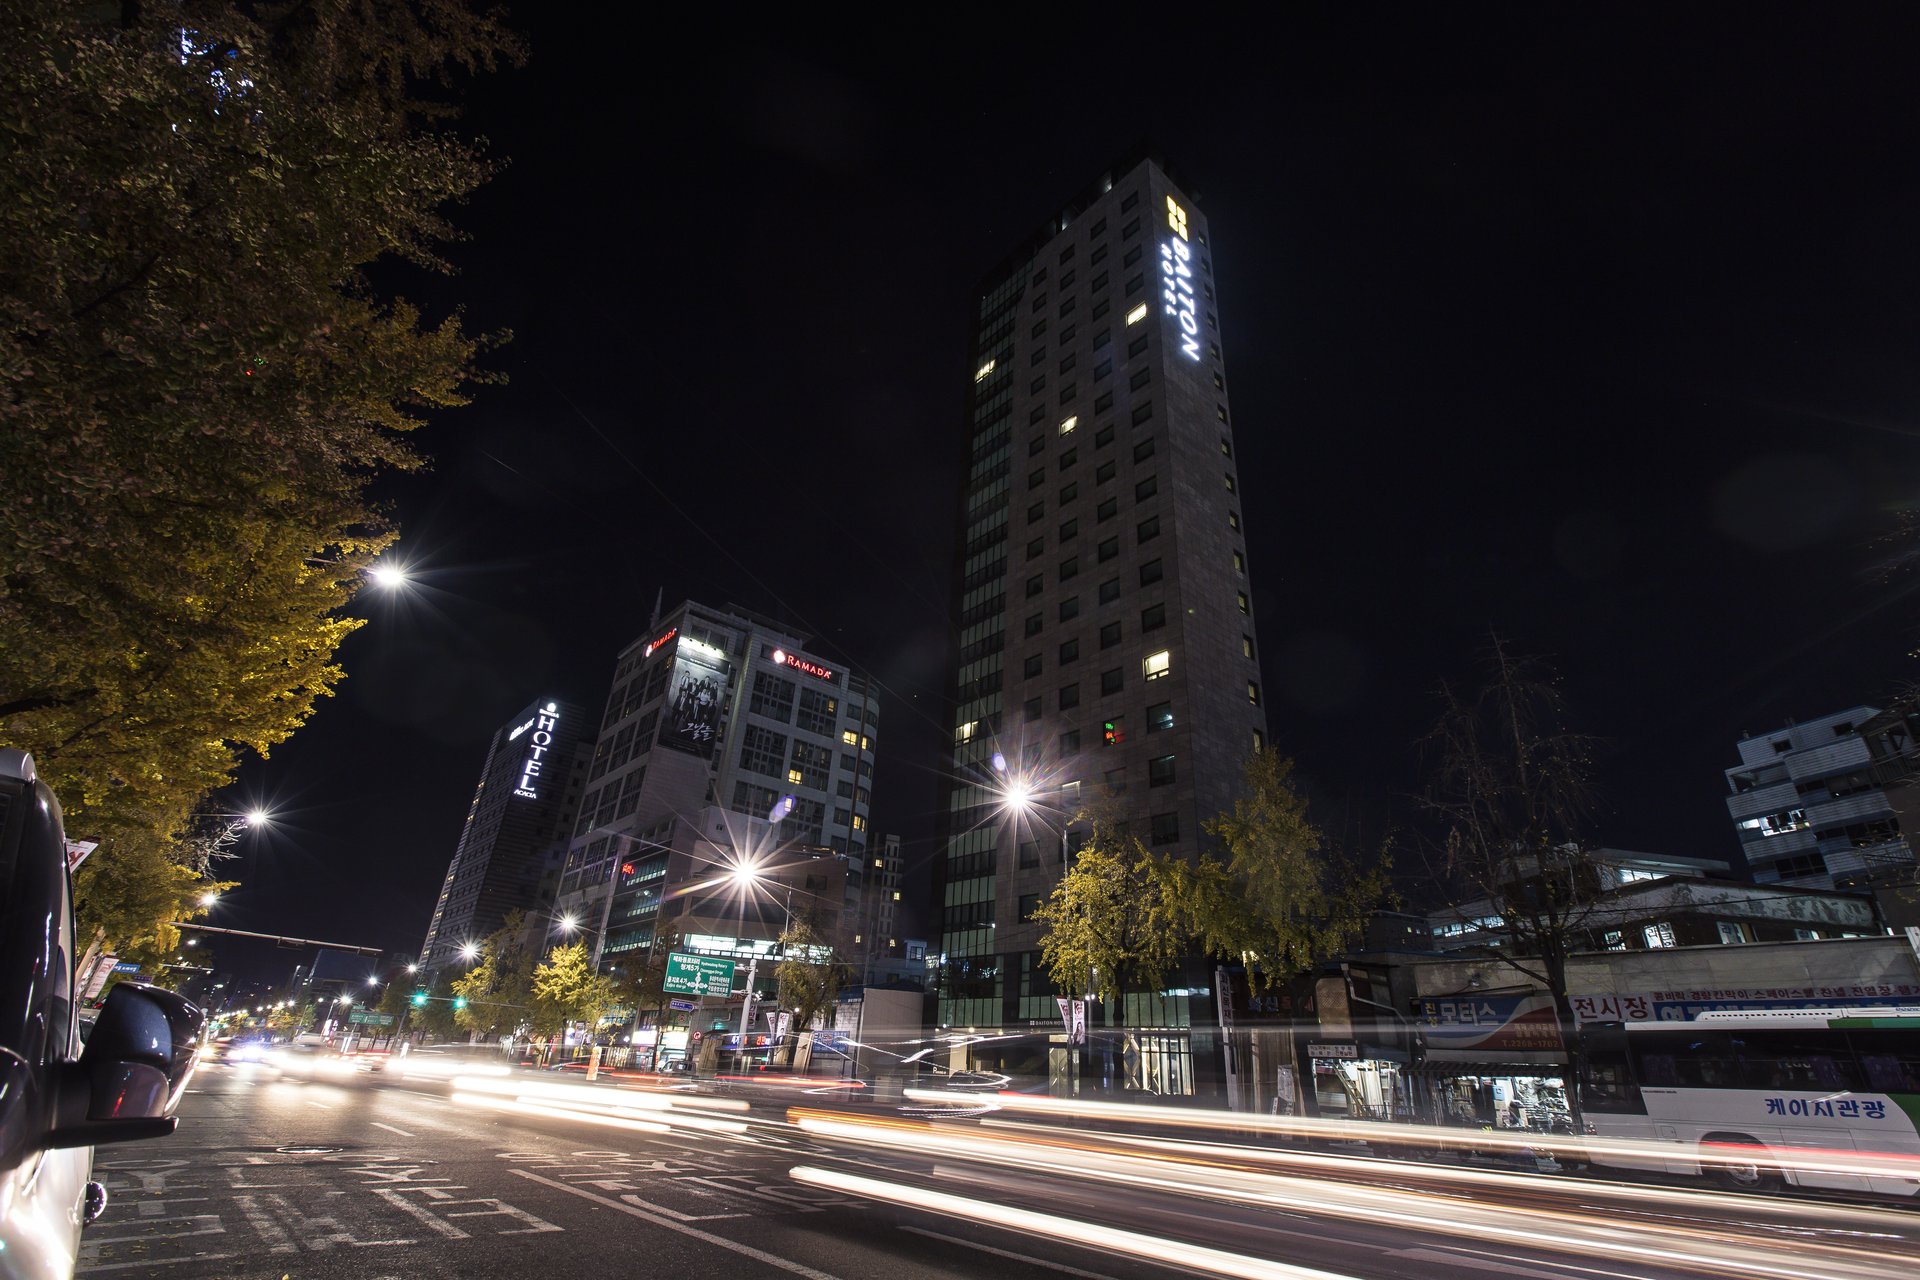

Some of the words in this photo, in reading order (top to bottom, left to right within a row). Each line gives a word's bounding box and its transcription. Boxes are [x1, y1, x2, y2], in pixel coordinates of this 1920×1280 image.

[1161, 243, 1177, 316] HOTEL
[1172, 237, 1200, 361] BAITON
[652, 628, 675, 650] RAMADA
[787, 654, 831, 679] RAMADA
[680, 722, 715, 742] 그날들
[520, 715, 556, 791] HOTEL
[514, 789, 537, 799] ACACIA
[1439, 1002, 1499, 1027] 모터스
[1574, 996, 1648, 1019] 전시장
